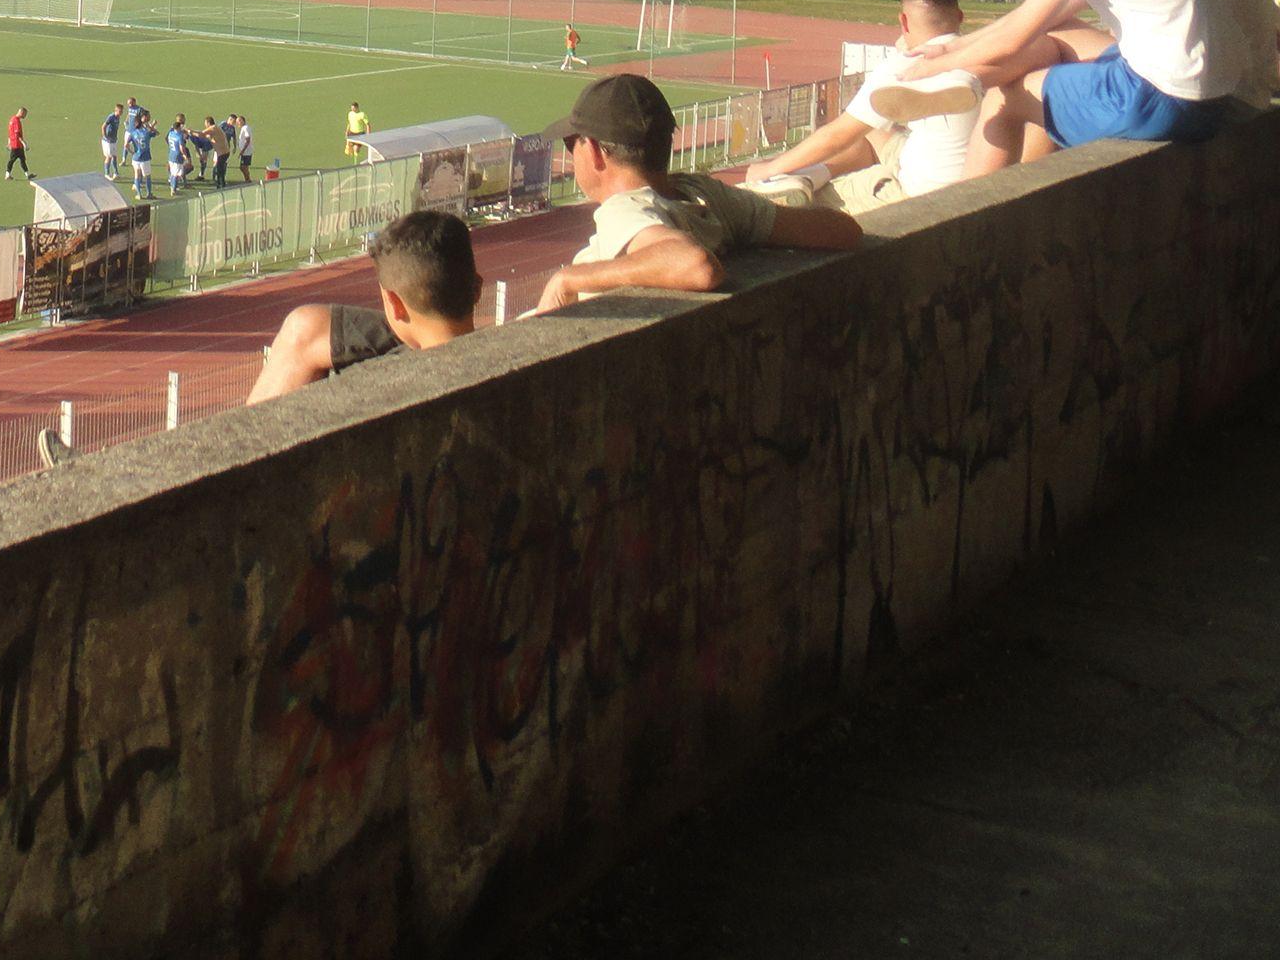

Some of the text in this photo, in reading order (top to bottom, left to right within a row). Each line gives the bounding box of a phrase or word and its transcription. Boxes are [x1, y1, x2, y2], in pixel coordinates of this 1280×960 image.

[317, 200, 400, 236] AUTO DAMIGOS
[185, 226, 283, 268] AUTO DAMIGOS
